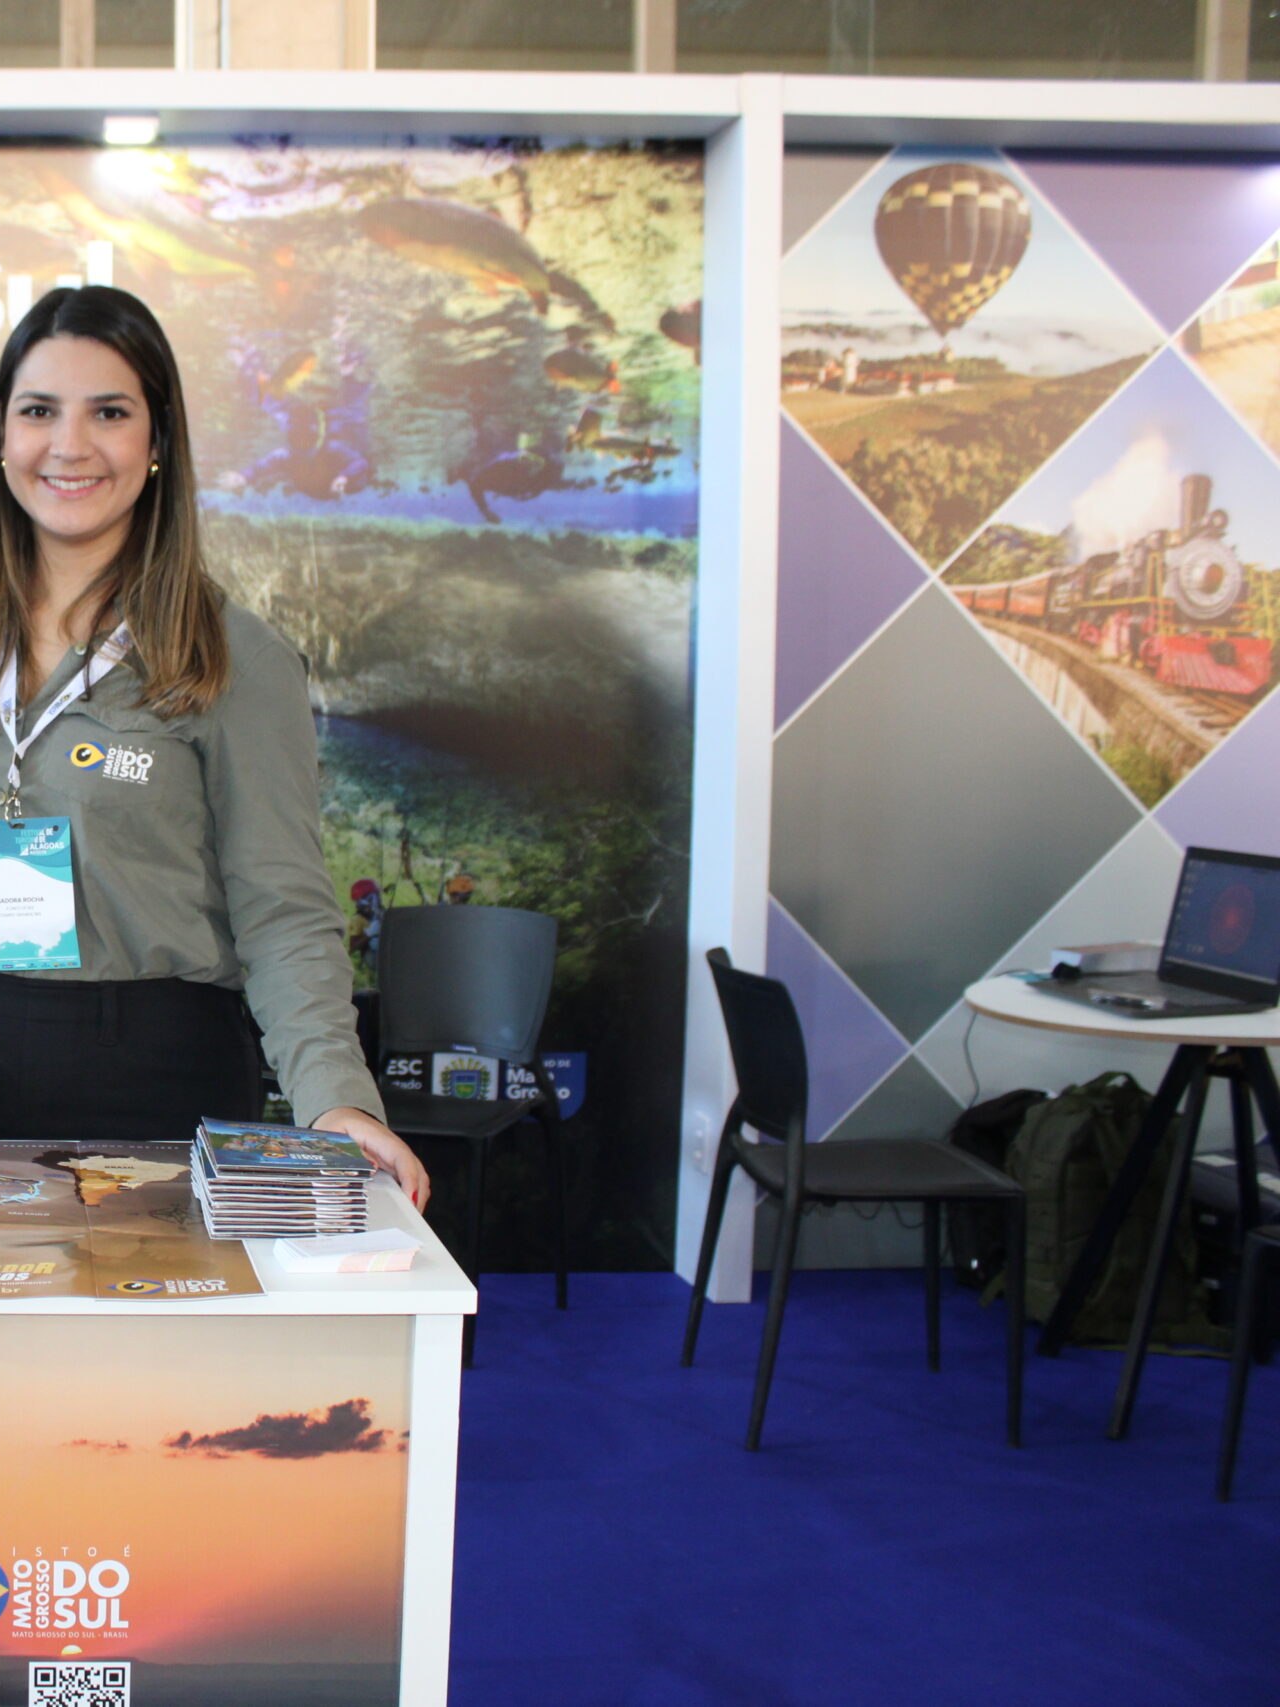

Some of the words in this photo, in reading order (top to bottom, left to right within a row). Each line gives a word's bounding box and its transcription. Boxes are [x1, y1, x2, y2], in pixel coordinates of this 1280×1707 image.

[104, 747, 116, 775] MATO
[122, 751, 153, 769] DO
[119, 765, 149, 781] SUL
[29, 842, 65, 850] ALAGOAS
[506, 1068, 555, 1083] Ma
[506, 1084, 571, 1099] Groo
[53, 1560, 130, 1598] DO
[13, 1559, 33, 1629] MATO
[35, 1559, 50, 1629] GROSSO
[53, 1598, 129, 1629] SUL
